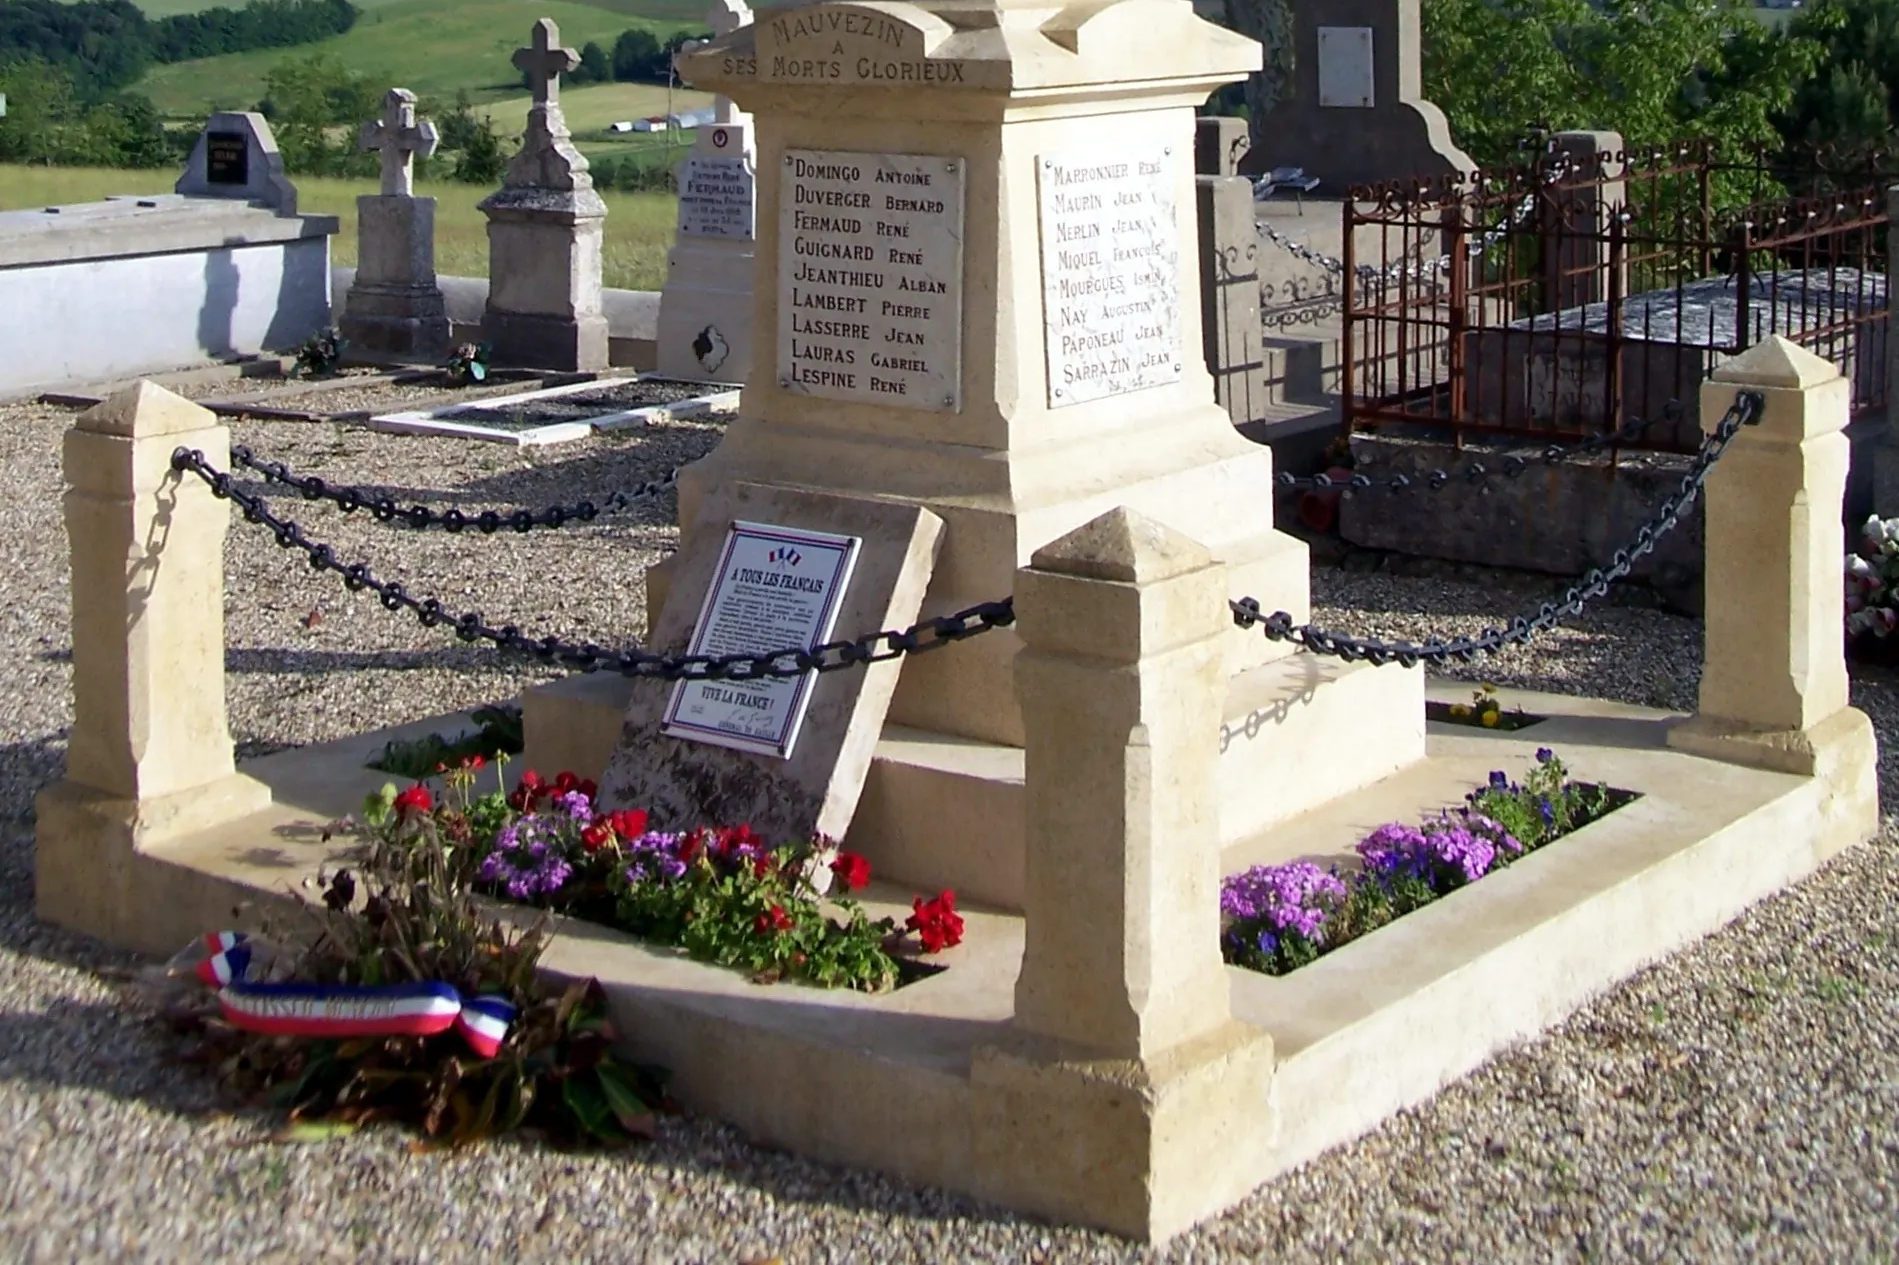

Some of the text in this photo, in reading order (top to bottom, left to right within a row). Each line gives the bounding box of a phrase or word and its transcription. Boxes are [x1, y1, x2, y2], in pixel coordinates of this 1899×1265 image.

[772, 11, 904, 47] MAUVEZIN
[832, 41, 844, 55] A
[723, 57, 965, 83] SES MORTS GLORIEUX
[795, 159, 931, 186] DOMINGO ANTOINE
[795, 185, 944, 214] DUVERGER BERNARD
[1113, 191, 1142, 207] JEAN
[794, 211, 909, 238] FERMAUD RENÉ
[794, 236, 923, 265] GUIGNARD RENÉ
[794, 263, 946, 294] JEANTHIEU ALBAN
[793, 287, 930, 320] LAMBERT PIERRE
[792, 313, 924, 345] LASSERRE JEAN
[792, 338, 928, 373] LAURAS GABRIEL
[1141, 352, 1170, 368] JEAN
[792, 362, 906, 395] LESPINE RENÉ
[740, 568, 763, 584] TOUS
[763, 572, 781, 587] LES
[702, 686, 721, 701] VIVE
[721, 690, 735, 704] LA
[734, 692, 770, 710] FRANCE
